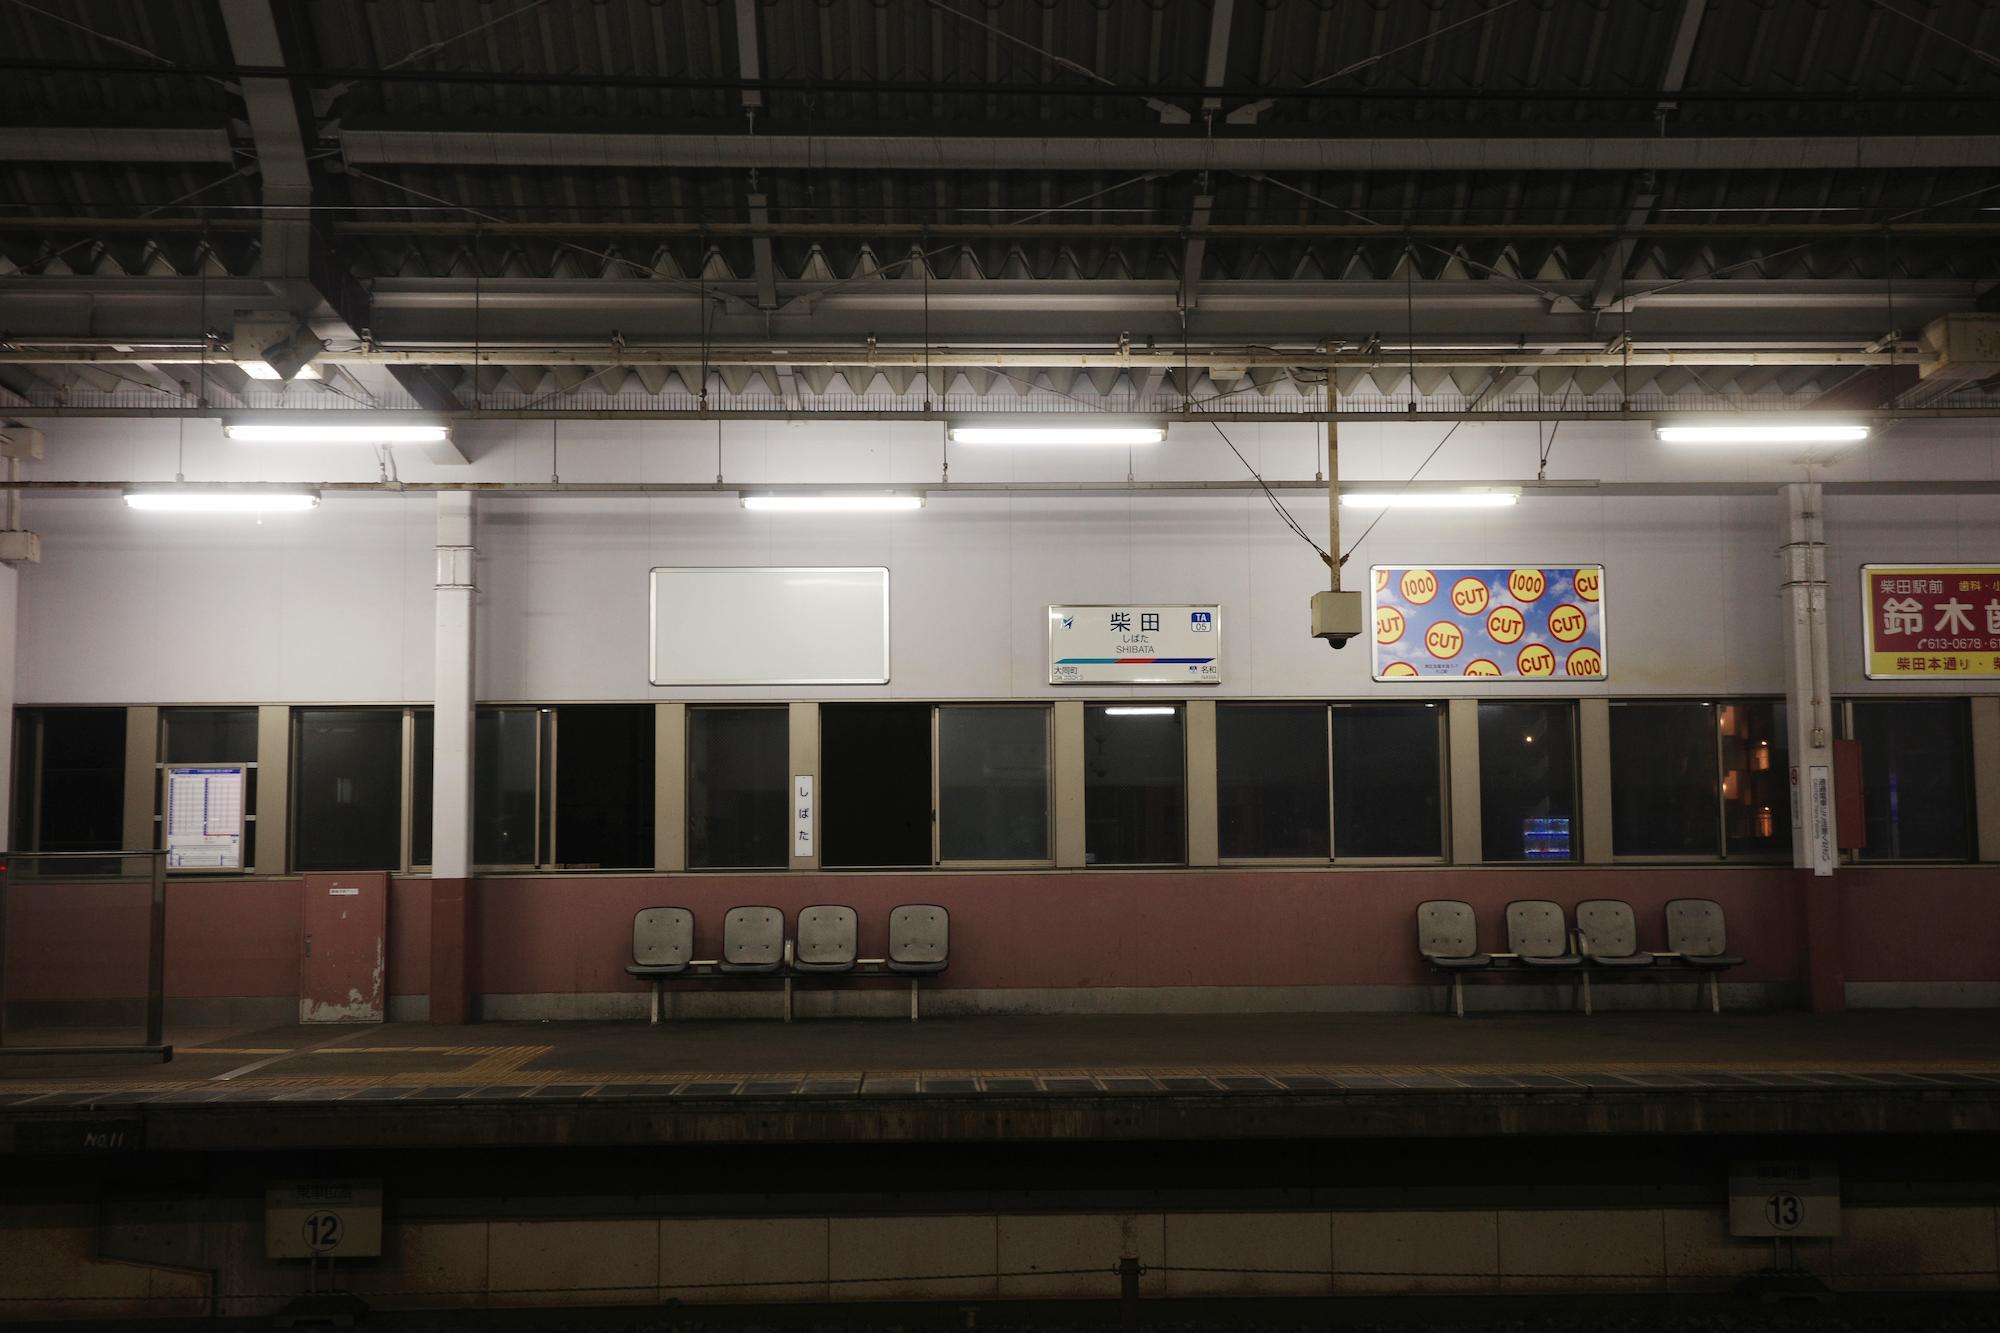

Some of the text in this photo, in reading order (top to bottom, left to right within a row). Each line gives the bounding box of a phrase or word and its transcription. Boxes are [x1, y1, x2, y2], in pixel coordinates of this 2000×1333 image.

[1405, 576, 1433, 597] 1000
[1512, 572, 1542, 594] 1000
[1577, 573, 1599, 593] CU
[1880, 579, 1944, 594] 柴田駅前
[1454, 588, 1484, 607] CUT
[1110, 612, 1160, 632] 柴田
[1195, 613, 1207, 622] TA
[1195, 622, 1207, 631] 05
[1490, 618, 1522, 635] CUT
[1551, 615, 1581, 633] CUT
[1122, 634, 1149, 644] しばた
[1428, 632, 1460, 650] CUT
[1116, 645, 1155, 654] SHIBATA
[1520, 654, 1550, 674] CUT
[1571, 657, 1600, 676] 1000
[798, 786, 810, 841] しばた
[1769, 1195, 1798, 1225] 13
[307, 1215, 338, 1245] 12
